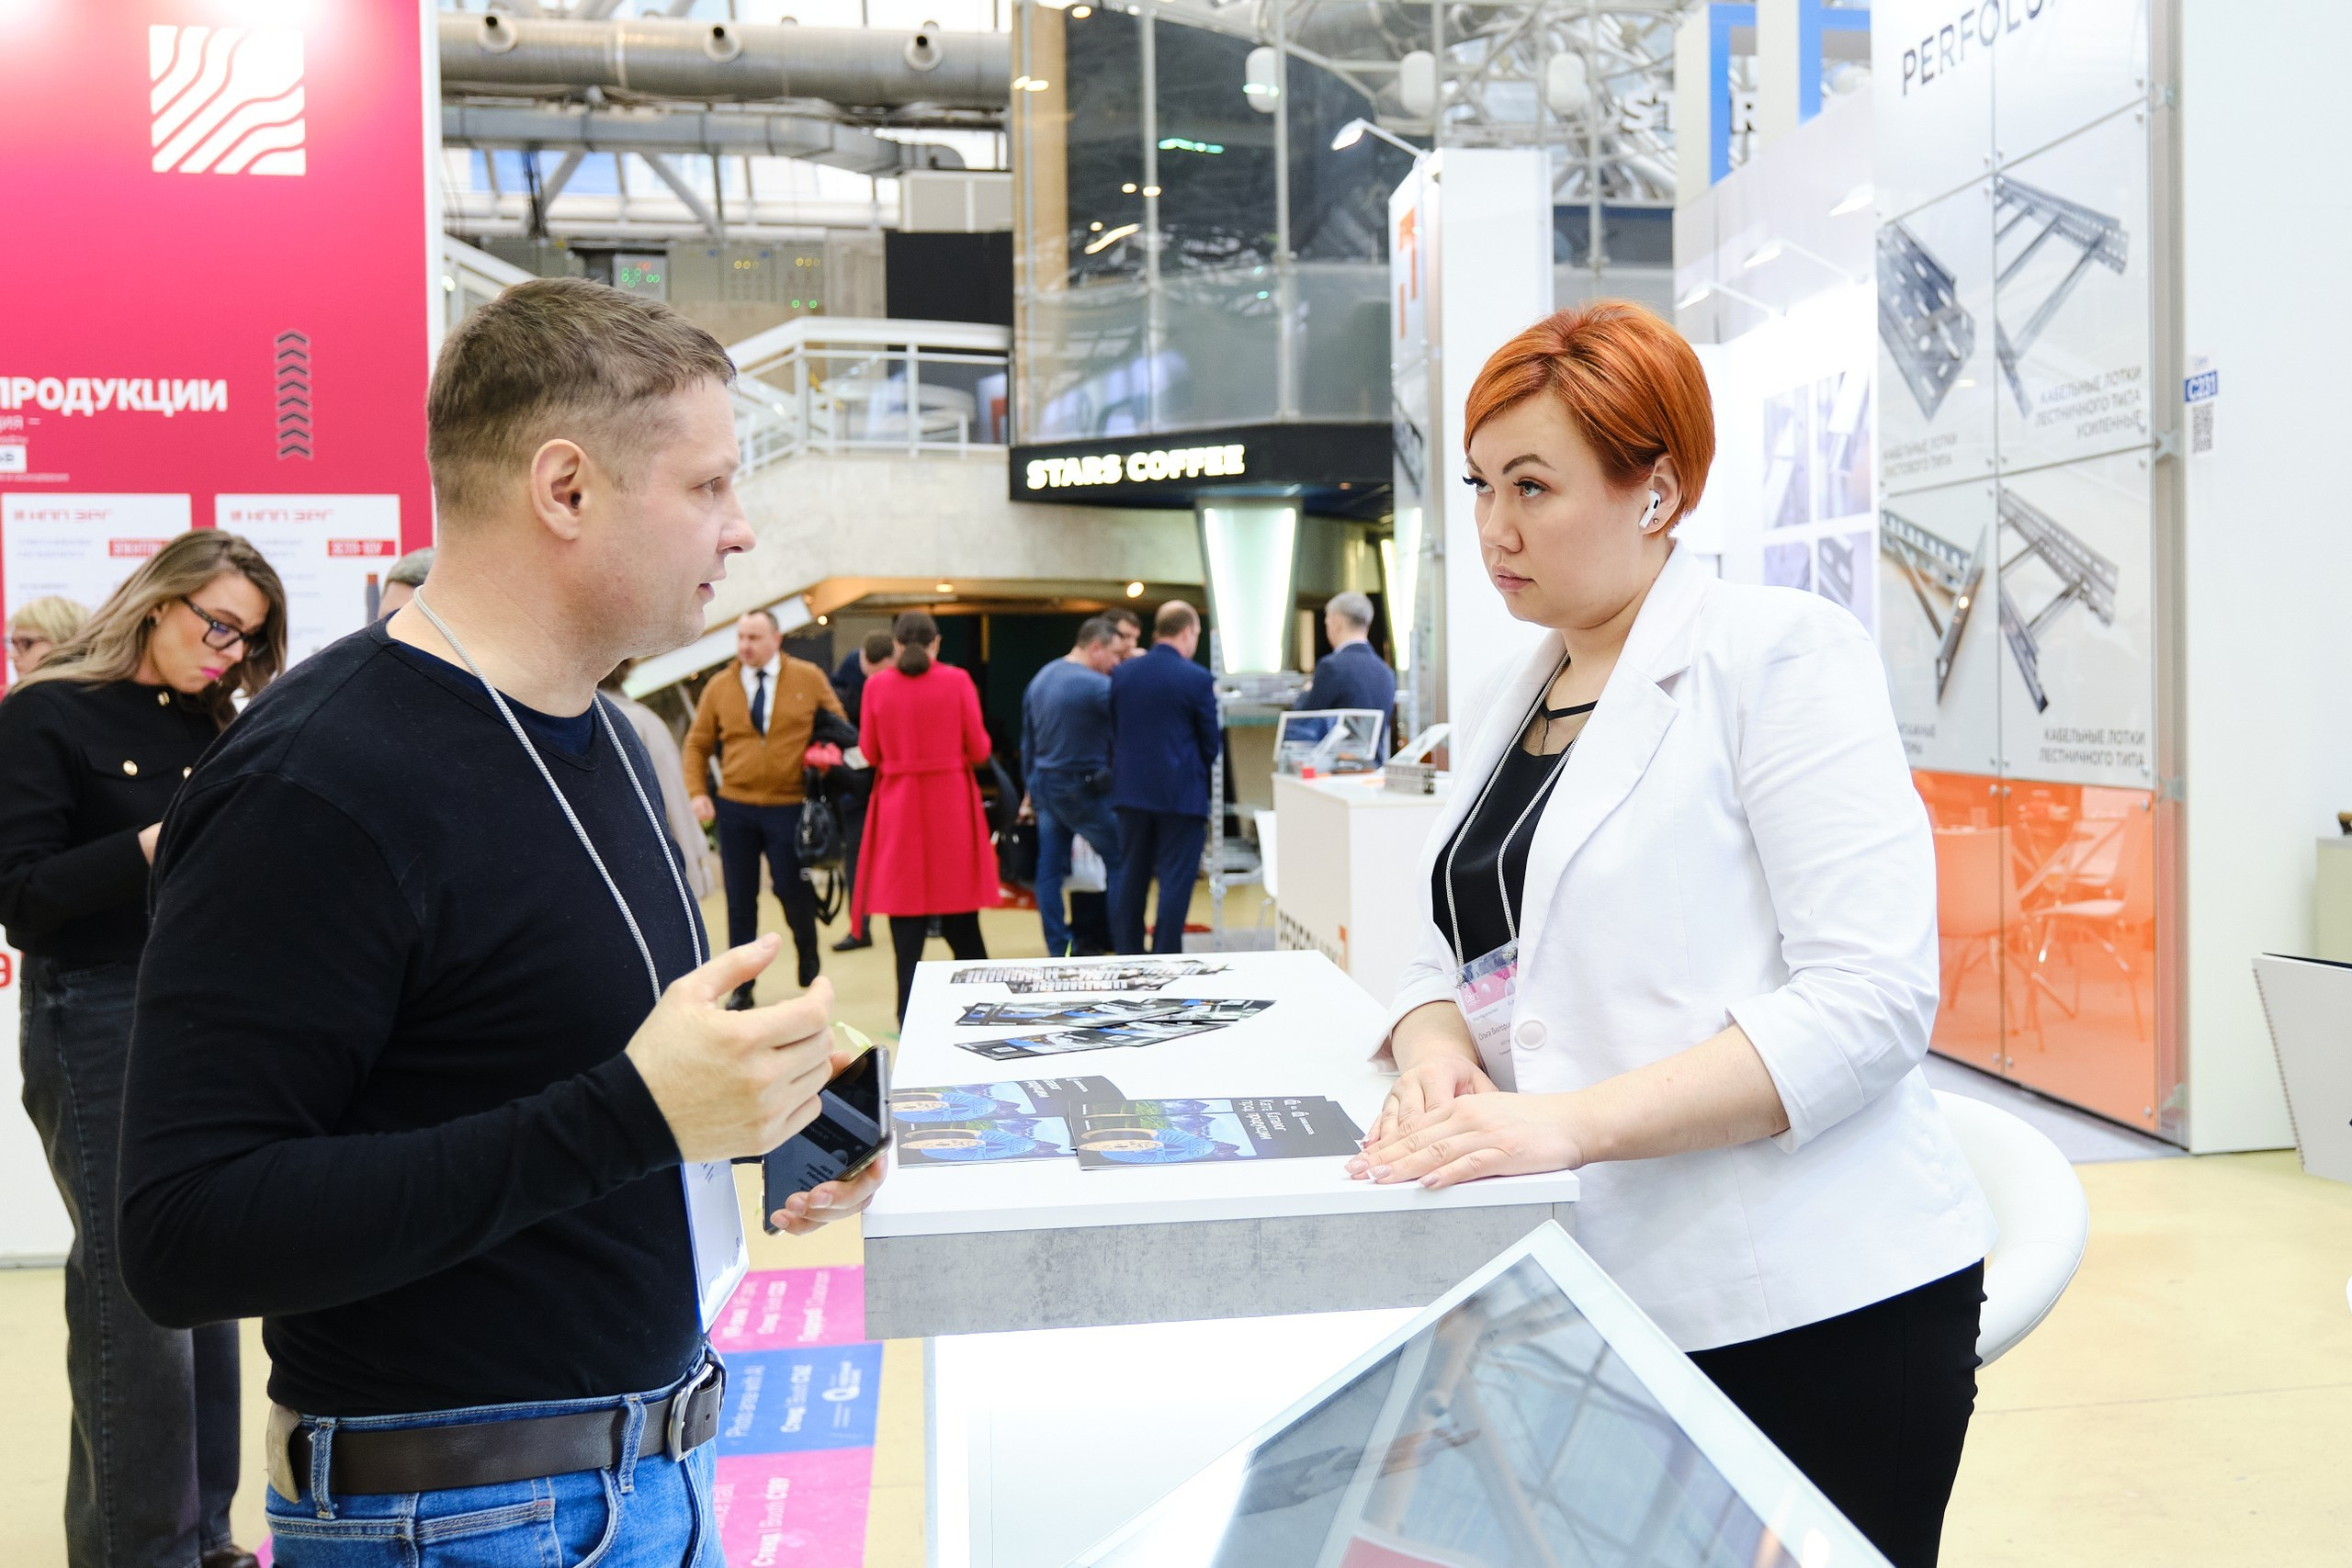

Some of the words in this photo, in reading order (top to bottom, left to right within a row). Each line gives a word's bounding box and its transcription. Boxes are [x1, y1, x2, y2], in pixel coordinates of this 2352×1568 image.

[1903, 0, 2056, 96] PERFOL
[1026, 454, 1123, 490] STARS
[1125, 444, 1245, 482] COFFEE
[2044, 728, 2104, 744] КАБЕЛЬНЫЕ
[2108, 729, 2146, 745] ЛОТКИ
[2039, 748, 2112, 766] ЛЕСТНИЧНОГО
[2116, 751, 2145, 768] ТИПА
